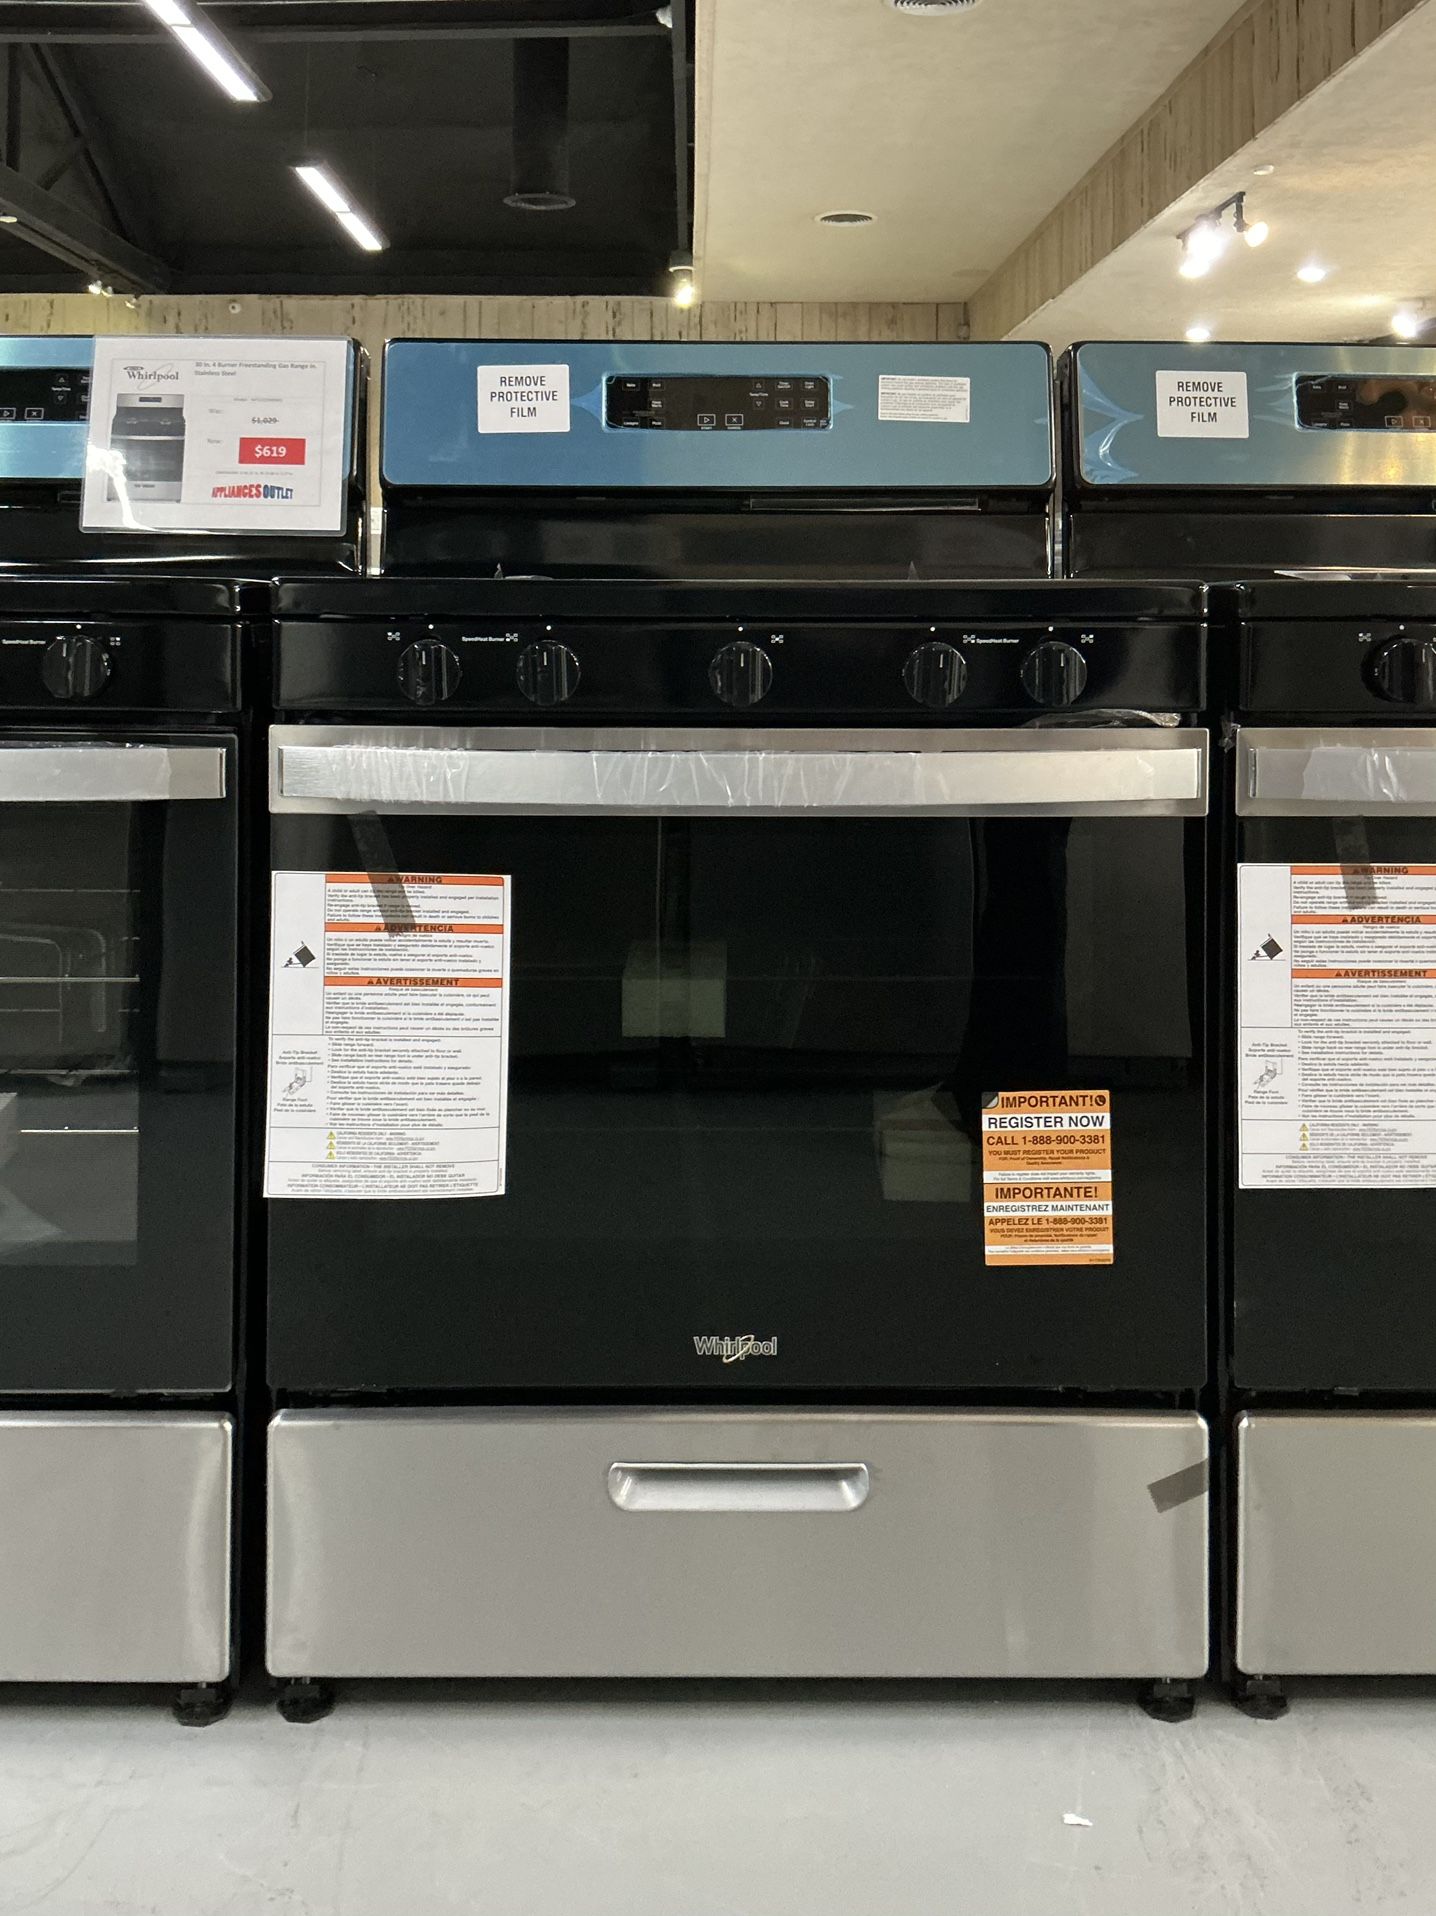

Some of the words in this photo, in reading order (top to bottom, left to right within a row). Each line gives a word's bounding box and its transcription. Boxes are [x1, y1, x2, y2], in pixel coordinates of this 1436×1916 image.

[127, 371, 179, 382] Whirlpool
[499, 375, 546, 387] REMOVE
[1177, 381, 1223, 392] REMOVE
[489, 390, 559, 402] PROTECTIVE
[1168, 396, 1237, 408] PROTECTIVE
[509, 406, 537, 418] FILM
[1190, 411, 1218, 423] FILM
[254, 444, 286, 458] $619
[211, 484, 262, 499] APPLIANCES
[262, 484, 294, 499] OUTLET
[375, 978, 460, 986] AVERTISSEMENT
[1001, 1095, 1093, 1108] IMPORTANT!
[988, 1117, 1064, 1129] REGISTER
[1068, 1115, 1105, 1128] NOW
[986, 1136, 1019, 1146] CALL
[1022, 1135, 1105, 1145] 1-888-900-3381
[995, 1186, 1098, 1199] IMPORTANTE!
[986, 1205, 1049, 1213] ENREGISTREZ
[1051, 1203, 1110, 1212] MAINTENANT
[988, 1218, 1029, 1226] APPELEZ
[1031, 1217, 1043, 1225] LE
[1045, 1217, 1108, 1225] 1-888-900-3381
[693, 1335, 777, 1361] Whirlpool
